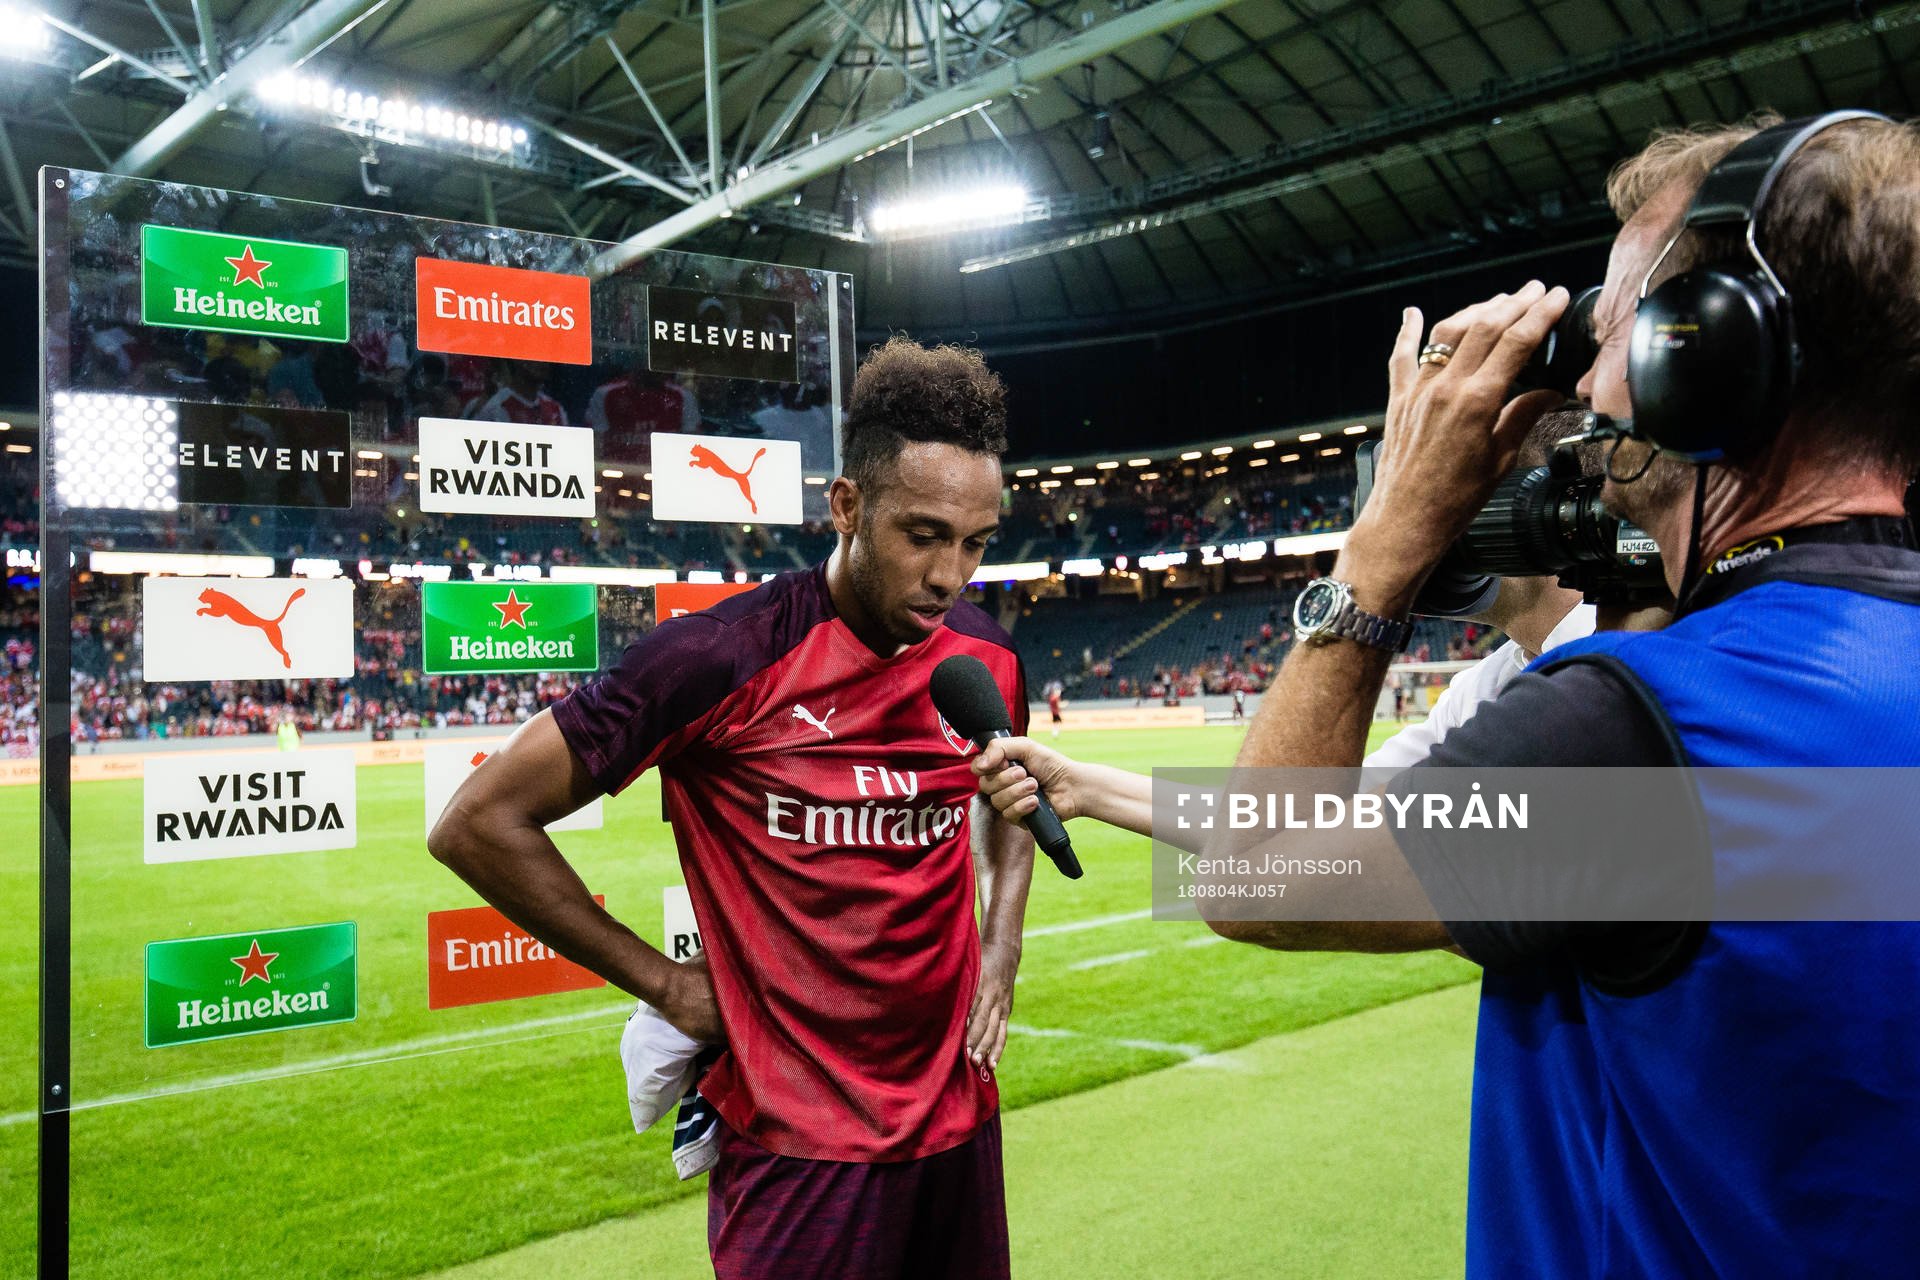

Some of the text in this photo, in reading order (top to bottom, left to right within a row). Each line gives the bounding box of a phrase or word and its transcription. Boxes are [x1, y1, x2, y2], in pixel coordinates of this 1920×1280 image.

[174, 287, 321, 326] Heineken
[434, 286, 575, 331] Emirates
[654, 320, 793, 353] RELEVENT
[179, 443, 344, 473] ELEVENT
[464, 439, 552, 468] VISIT
[430, 468, 585, 500] RWANDA
[450, 633, 574, 660] Heineken
[198, 770, 306, 804] VISIT
[852, 765, 918, 802] Fly
[156, 802, 345, 842] RWANDA
[764, 792, 964, 846] Emirates
[177, 987, 328, 1029] Heineken
